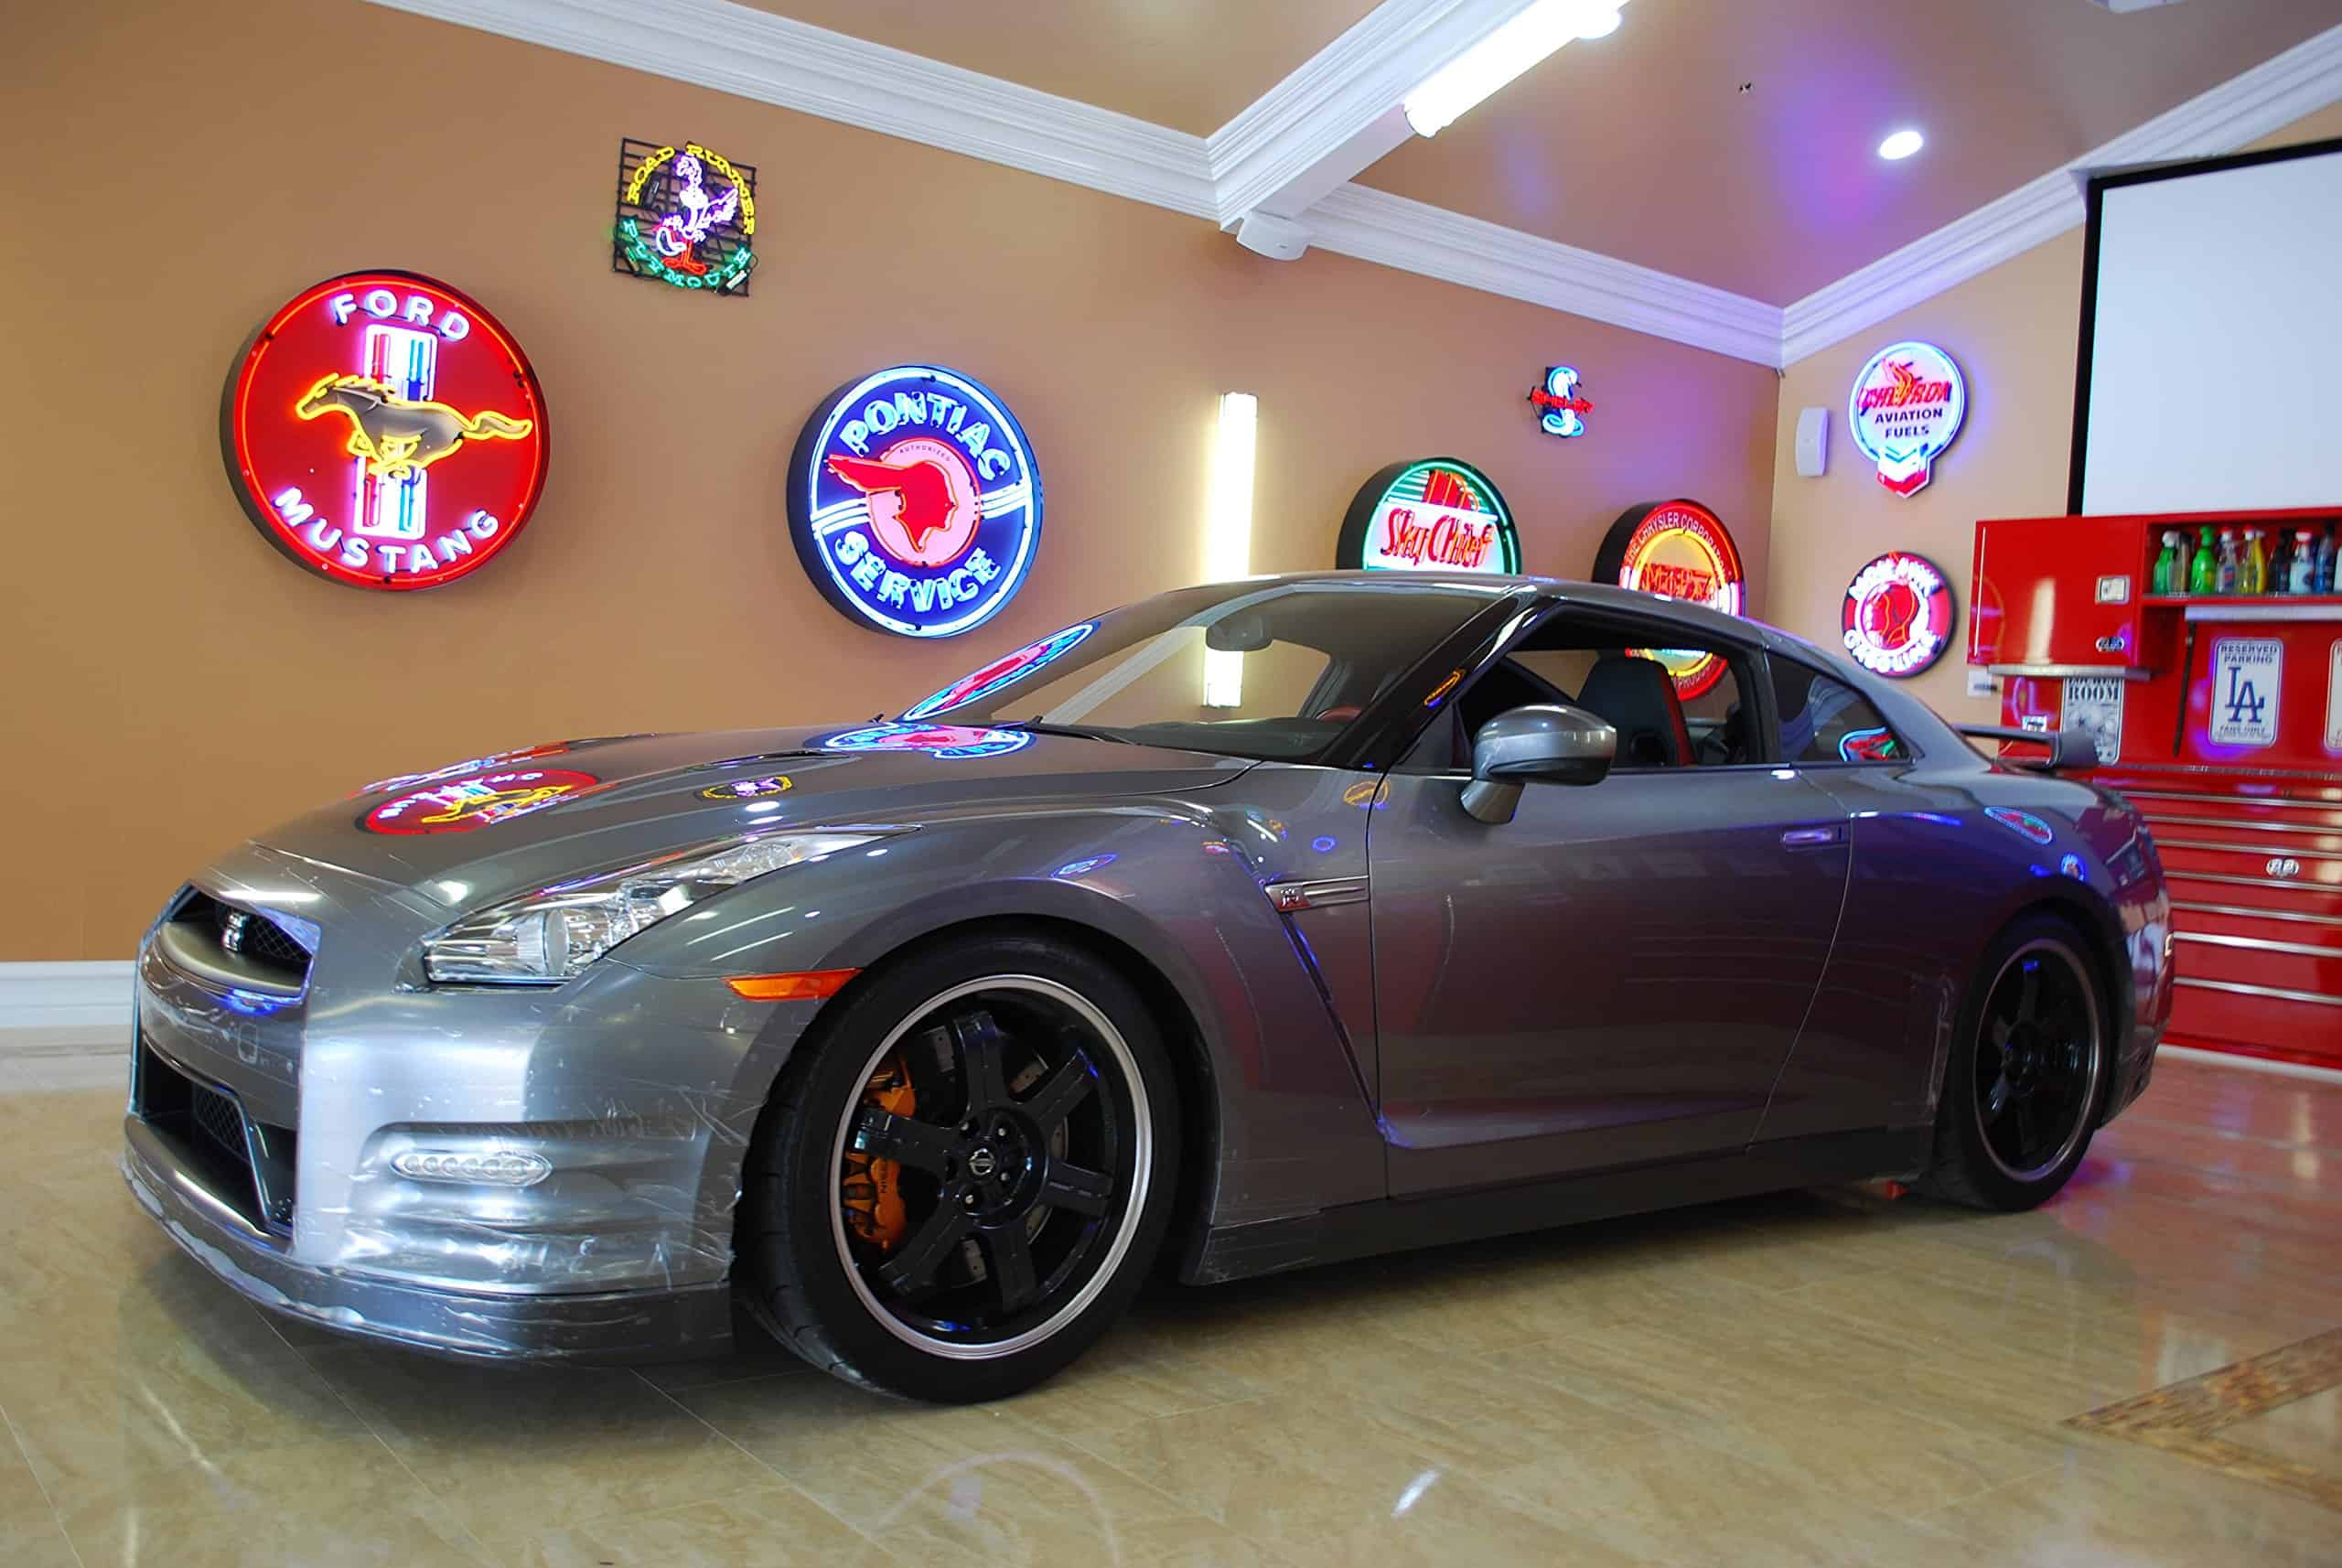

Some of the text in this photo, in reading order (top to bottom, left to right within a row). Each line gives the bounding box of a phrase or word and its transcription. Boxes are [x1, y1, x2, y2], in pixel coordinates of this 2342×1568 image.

[627, 144, 755, 235] ROAD RUNNER
[623, 220, 751, 287] PLYMOUTH
[330, 288, 470, 341] FORD
[839, 391, 1011, 481] PONTIAC
[1875, 408, 1943, 424] AVIATION
[1885, 425, 1929, 438] FUELS
[274, 486, 500, 575] MUSTANG
[1638, 511, 1680, 544] CHRYSLER
[835, 531, 1001, 612] SERVICE
[2220, 643, 2278, 653] RESERVED
[2224, 654, 2272, 664] PARKING
[2068, 687, 2119, 701] ROOM
[2224, 666, 2265, 723] LA
